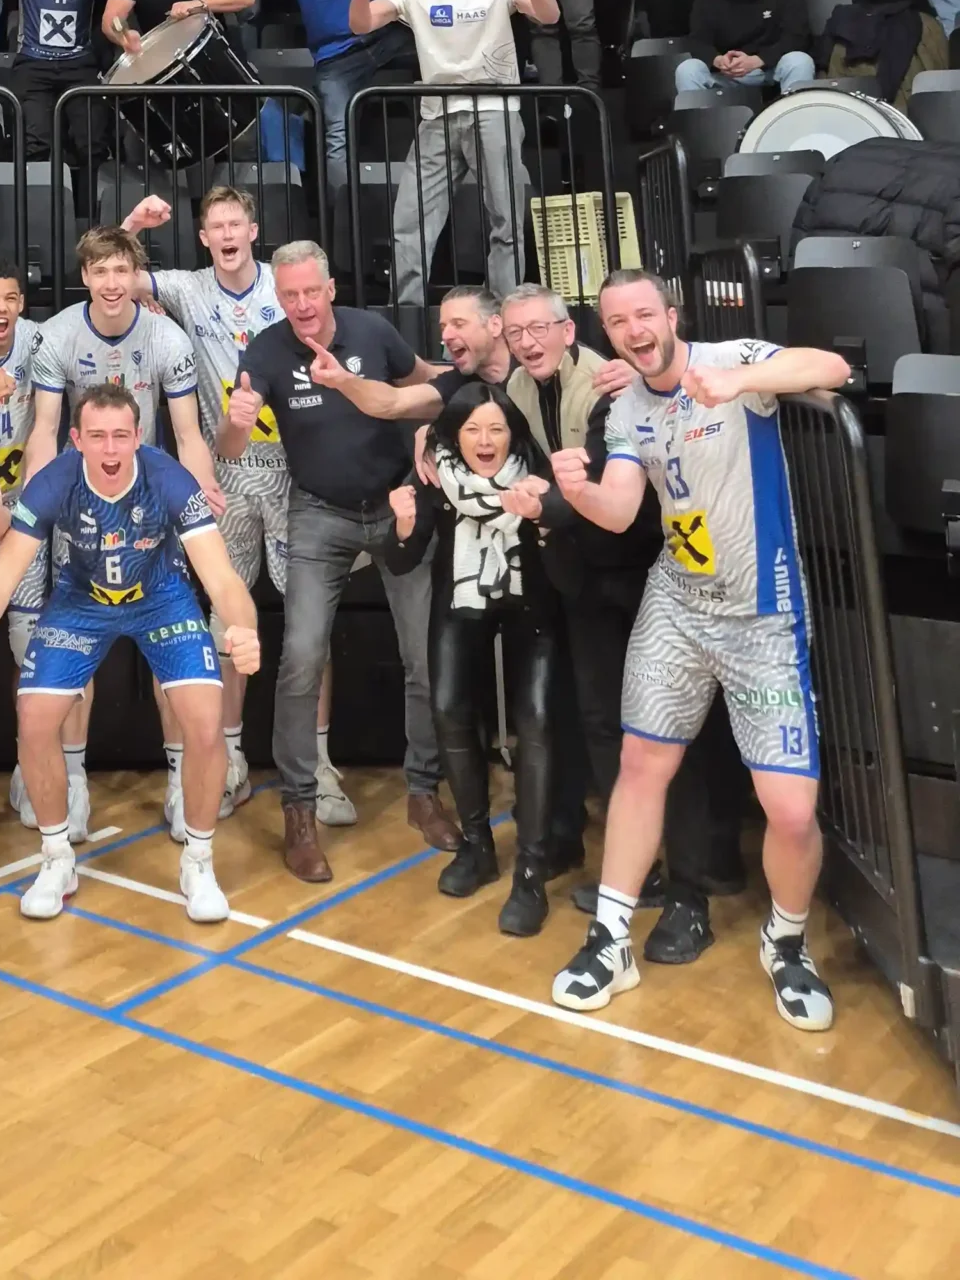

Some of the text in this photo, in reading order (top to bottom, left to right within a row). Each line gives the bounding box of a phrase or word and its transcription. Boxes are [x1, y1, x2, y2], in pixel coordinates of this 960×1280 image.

[456, 9, 487, 20] HAAS
[294, 382, 312, 391] nine
[300, 396, 322, 406] HAAS
[216, 453, 288, 468] hartber
[106, 555, 122, 584] 6
[775, 568, 791, 613] nine
[149, 619, 209, 643] teubl
[202, 646, 215, 671] 6
[778, 725, 803, 755] 13
